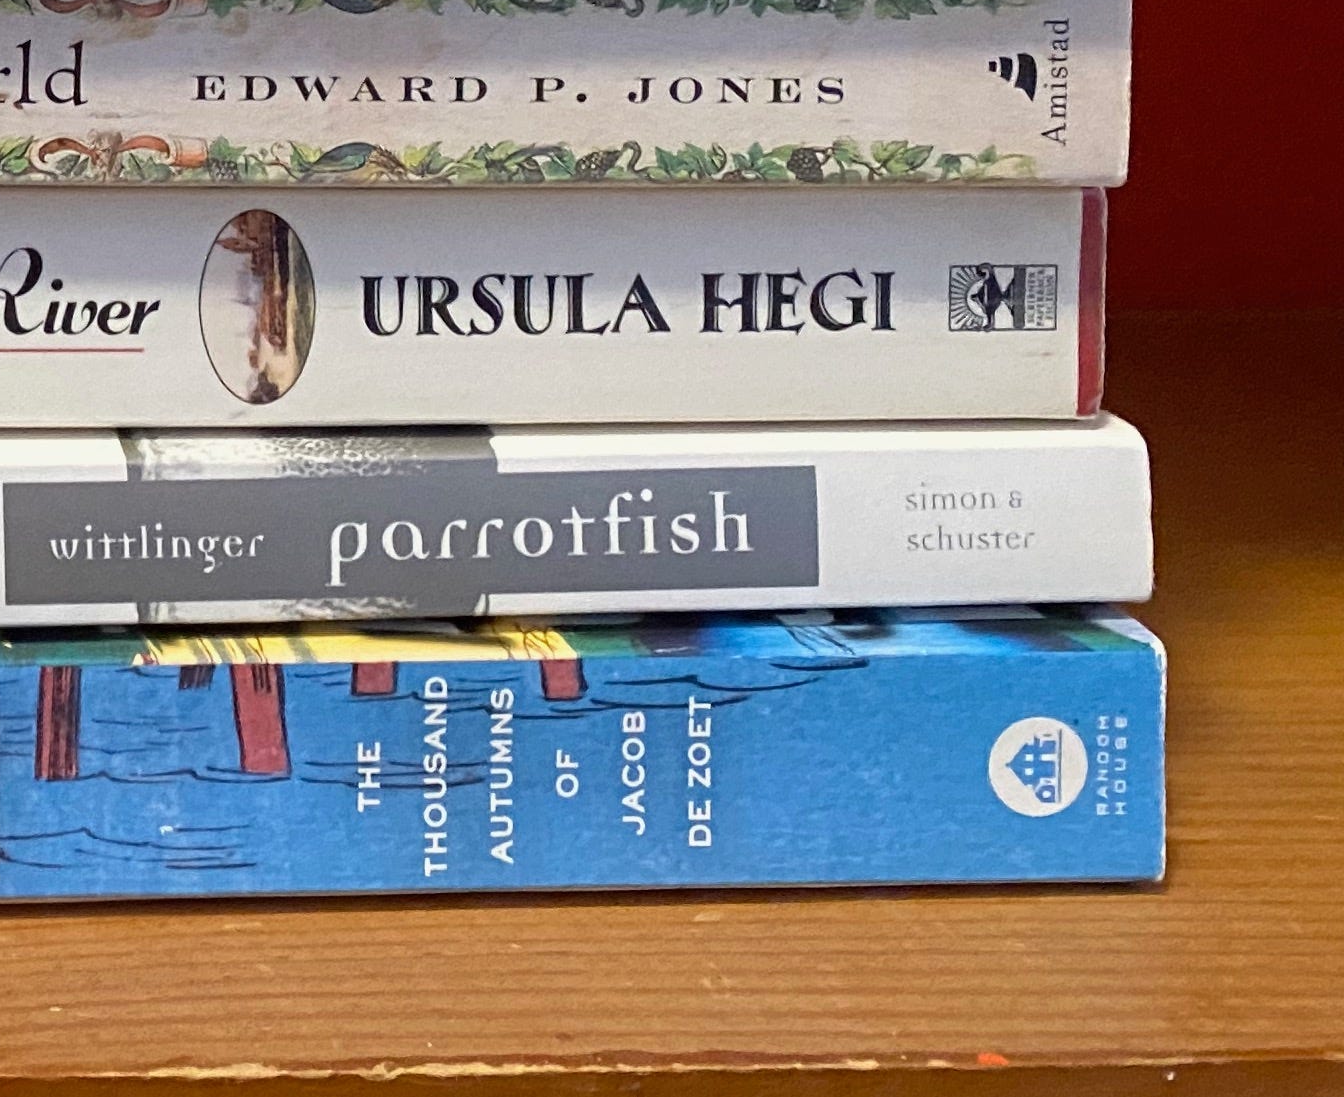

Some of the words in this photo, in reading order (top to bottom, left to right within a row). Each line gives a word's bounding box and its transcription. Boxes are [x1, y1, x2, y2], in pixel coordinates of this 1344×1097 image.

[194, 75, 489, 105] EDWARD
[530, 75, 589, 104] P.
[626, 74, 847, 106] JONES
[1040, 16, 1072, 148] Amistad
[360, 272, 671, 337] URSULA
[700, 268, 897, 334] HEGI
[49, 524, 264, 573] wittlinger
[326, 489, 754, 588] parrotfish
[905, 481, 996, 510] simon
[1008, 490, 1022, 509] &
[906, 525, 1035, 551] schuster
[358, 741, 381, 812] THE
[424, 676, 449, 877] THOUSAND
[491, 687, 515, 865] AUTUMNS
[556, 750, 579, 797] OF
[622, 710, 646, 836] JACOB
[688, 696, 713, 788] ZOET
[1096, 715, 1110, 816] RANDOM
[1114, 716, 1128, 815] HOUSE
[688, 799, 712, 849] DE
